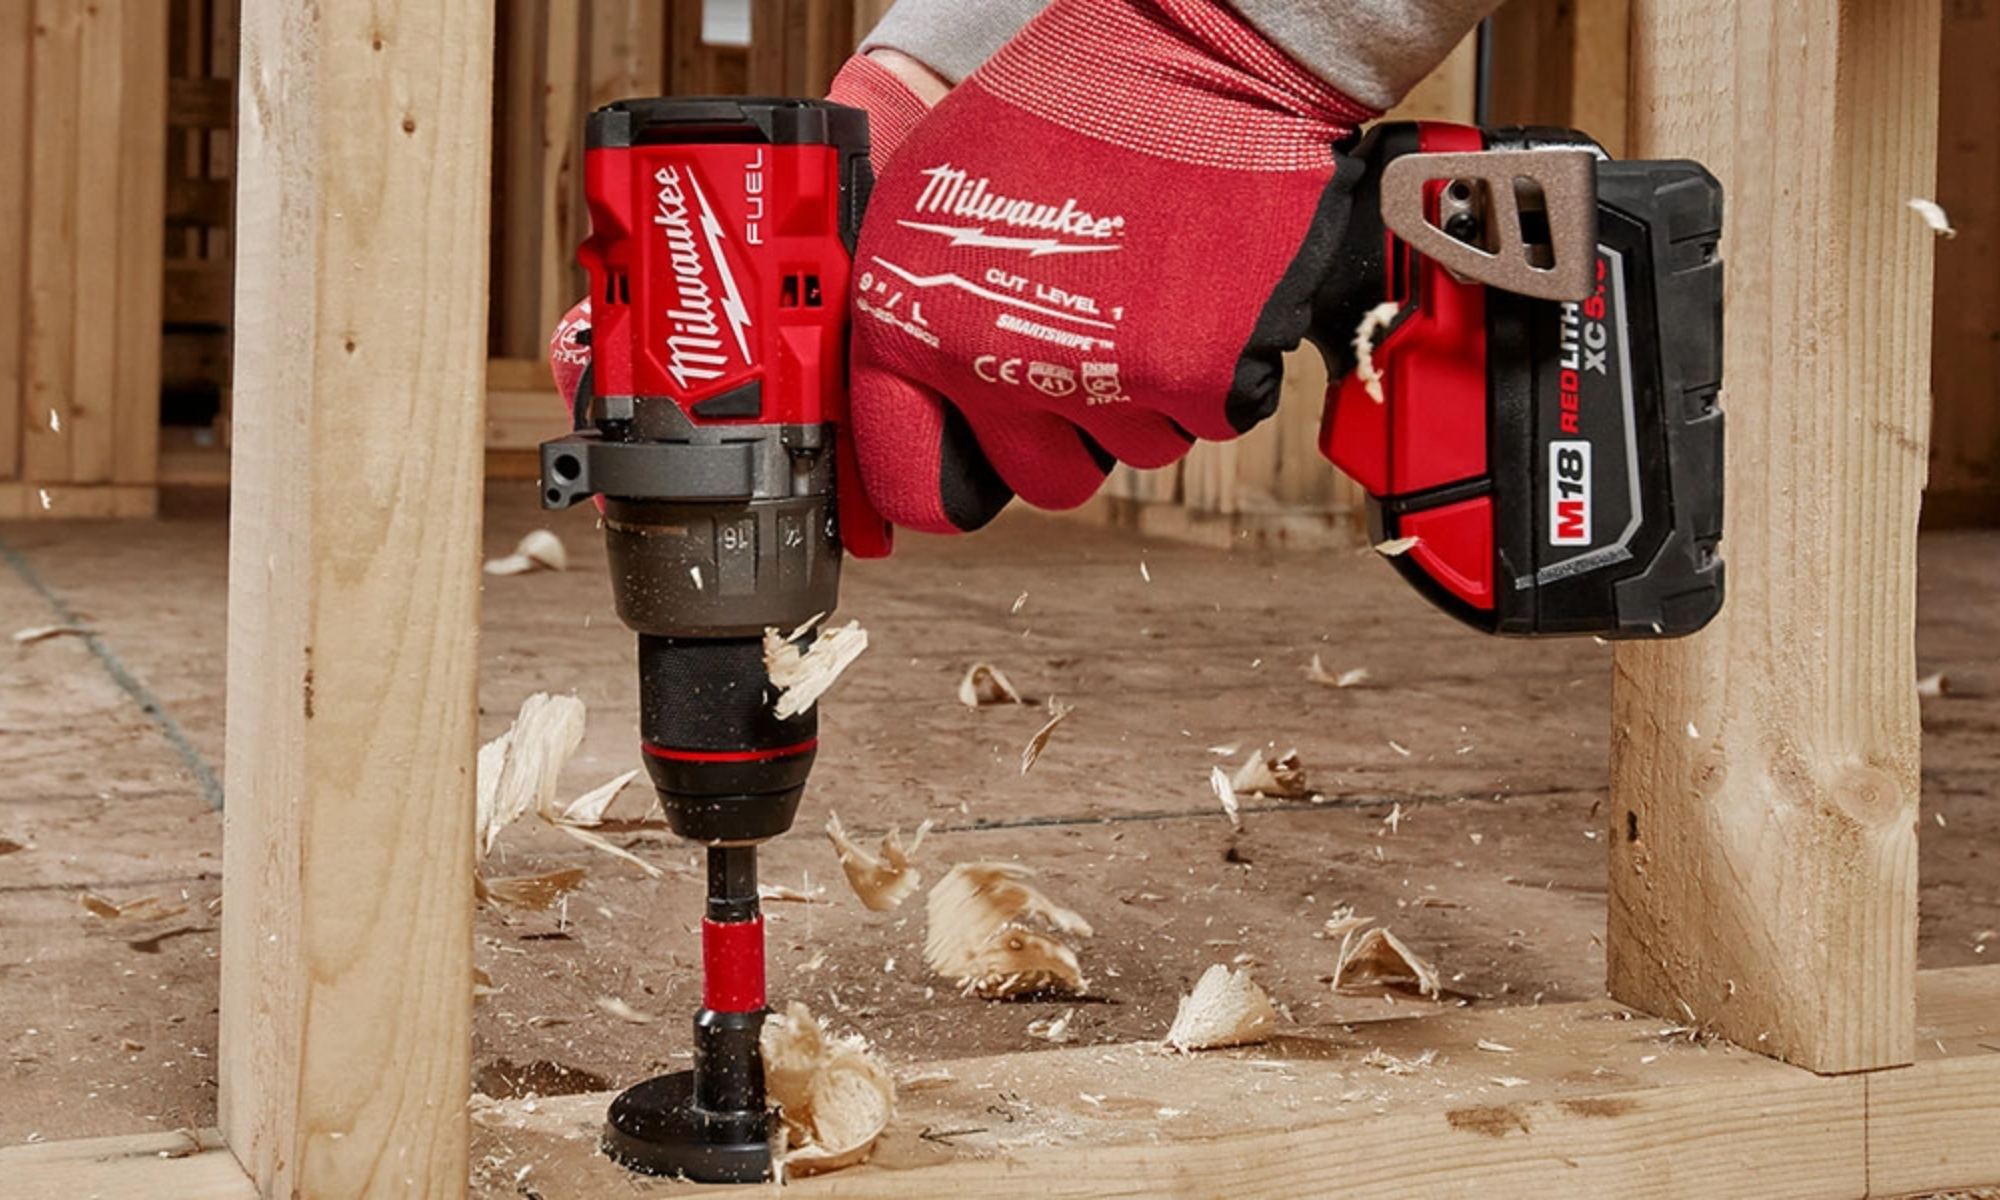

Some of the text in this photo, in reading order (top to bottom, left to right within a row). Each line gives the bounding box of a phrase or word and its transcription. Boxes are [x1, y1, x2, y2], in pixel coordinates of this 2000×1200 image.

[745, 148, 764, 246] FUEL
[653, 164, 729, 390] Milwaukee
[984, 267, 1124, 321] CUT LEVEL 1
[1040, 376, 1066, 393] A1
[1560, 299, 1580, 434] REDLITH
[723, 525, 749, 550] 16
[1556, 446, 1585, 539] M18
